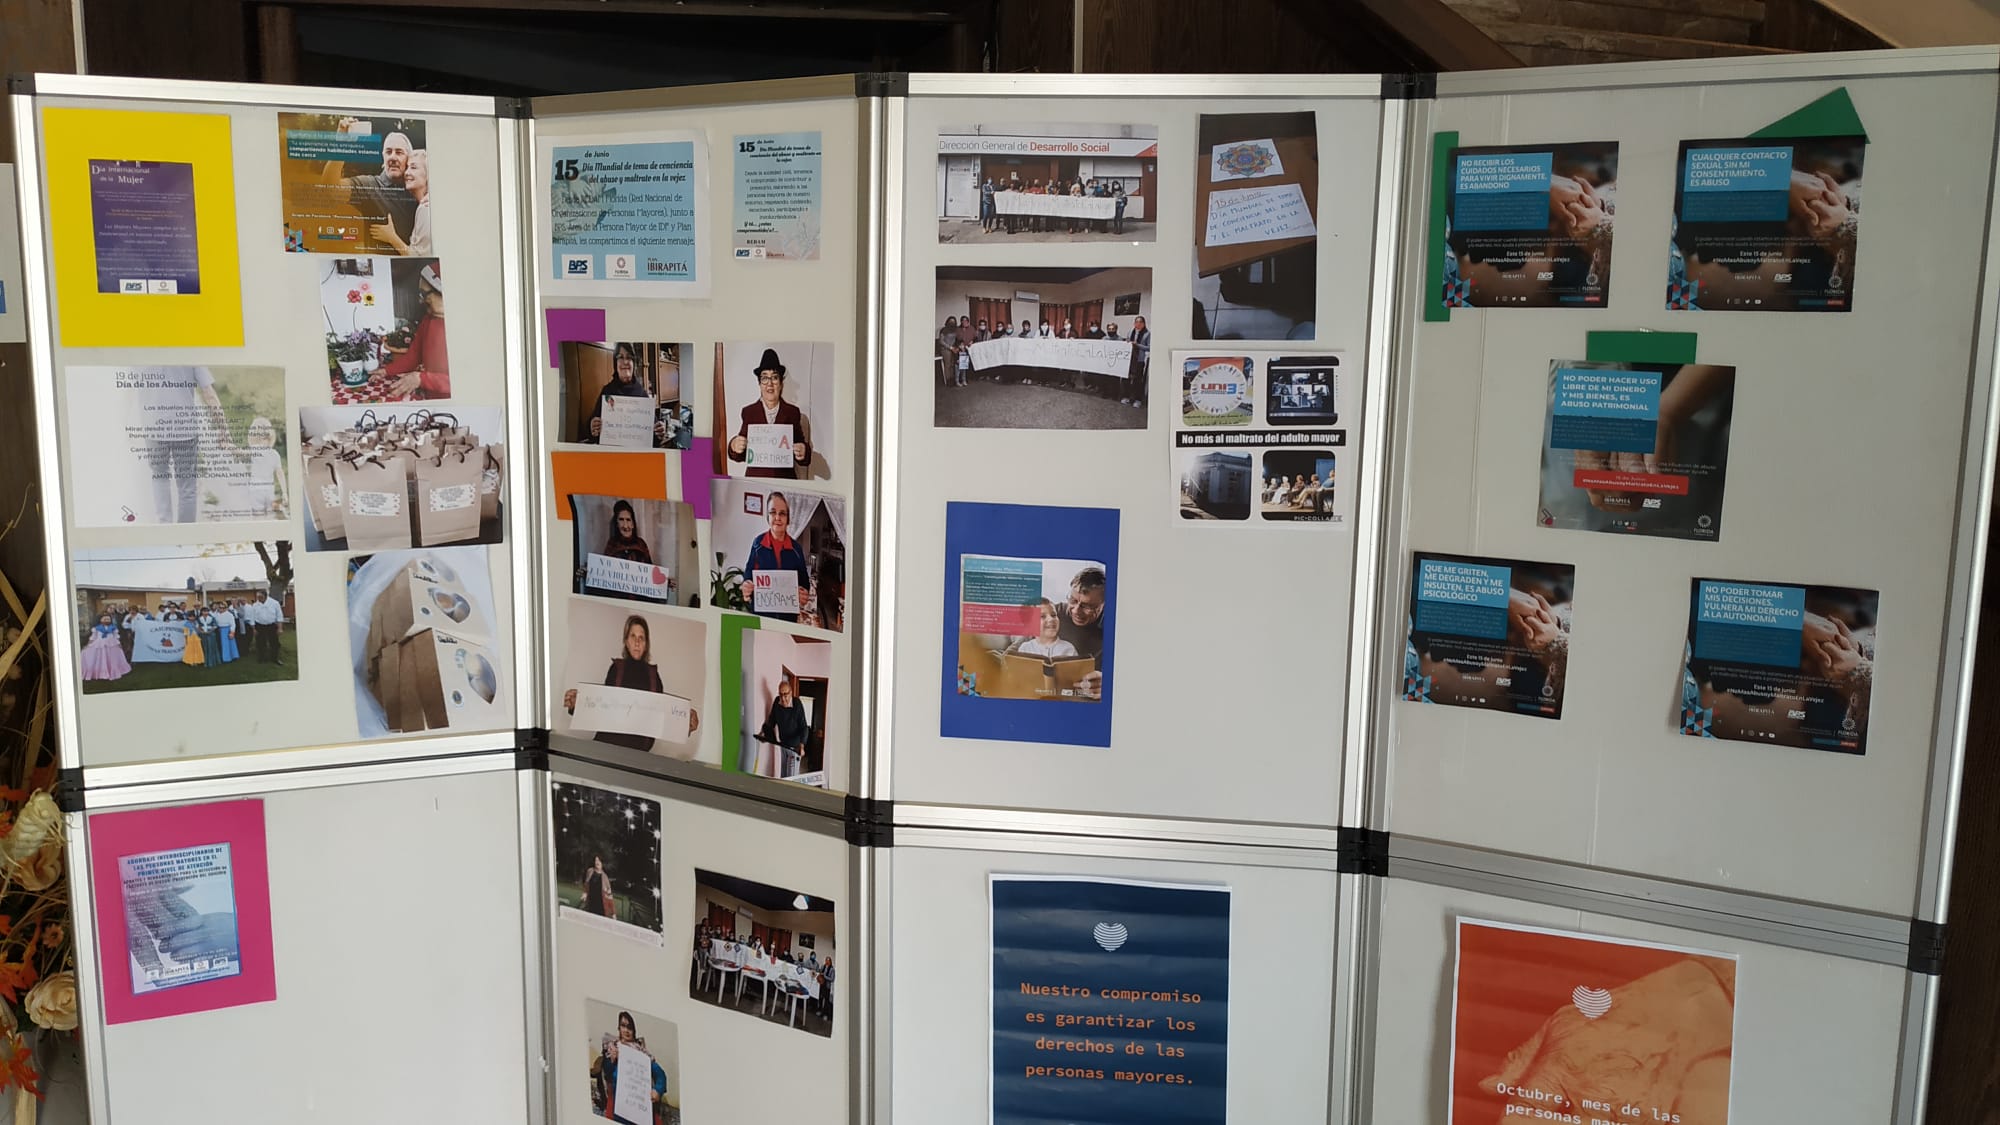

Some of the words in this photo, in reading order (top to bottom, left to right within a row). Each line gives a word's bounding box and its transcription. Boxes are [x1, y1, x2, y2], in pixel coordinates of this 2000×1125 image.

[739, 142, 755, 152] 15
[940, 140, 979, 150] Dirección
[982, 141, 1016, 150] General
[1017, 142, 1028, 151] de
[1030, 142, 1078, 152] Desarrollo
[1081, 142, 1110, 153] Social
[1692, 153, 1740, 162] CUALQUIER
[1741, 152, 1788, 160] CONTACTO
[555, 159, 579, 181] 15
[582, 162, 593, 172] Día
[595, 162, 622, 171] Mundial
[624, 162, 631, 170] de
[650, 161, 657, 170] de
[1691, 161, 1722, 170] SEXUAL
[1724, 161, 1737, 169] SIN
[1738, 161, 1750, 169] MI
[118, 175, 144, 184] Mujer
[662, 173, 669, 182] la
[670, 173, 686, 183] vejez
[1690, 179, 1699, 187] ES
[1701, 178, 1729, 186] ABUSO
[1460, 182, 1468, 190] ES
[645, 193, 672, 202] Nacional
[674, 193, 682, 202] de
[568, 260, 588, 270] BPS
[648, 260, 687, 272] IBIRAPITÁ
[116, 372, 125, 380] 19
[128, 372, 139, 380] de
[141, 372, 165, 381] junio
[116, 380, 132, 388] Día
[134, 380, 145, 388] de
[147, 380, 160, 389] los
[162, 380, 198, 389] Abuelos
[1561, 401, 1590, 409] ABUSO
[1592, 402, 1649, 411] PATRIMONIAL
[779, 435, 790, 449] A
[1182, 434, 1193, 444] No
[1195, 433, 1214, 444] más
[1216, 434, 1224, 443] al
[1226, 434, 1263, 443] maltrato
[1265, 433, 1279, 443] del
[1281, 433, 1309, 443] adulto
[1311, 434, 1339, 444] mayor
[1425, 564, 1442, 573] QUE
[756, 575, 770, 588] NO
[1424, 573, 1437, 581] ME
[1439, 574, 1482, 585] DEGRADEN
[1490, 579, 1503, 587] ME
[1423, 590, 1477, 601] PSICOLÓGICO
[1476, 587, 1504, 595] ABUSO
[1705, 586, 1718, 594] NO
[1720, 587, 1750, 596] PODER
[1751, 590, 1783, 599] TOMAR
[1705, 594, 1722, 602] MIS
[1705, 602, 1744, 612] VULNERA
[1745, 605, 1756, 613] MI
[1758, 606, 1799, 617] DERECHO
[1723, 612, 1777, 623] AUTONOMÍA
[157, 848, 214, 860] INTERDISCIPLINARIO
[146, 860, 174, 870] PERSONAS
[187, 862, 213, 870] ATENCIÓN
[1021, 983, 1091, 998] Nuestro
[1101, 989, 1201, 1003] compromiso
[1026, 1012, 1045, 1023] es
[1056, 1013, 1155, 1028] garantizar
[1167, 1017, 1196, 1031] los
[1036, 1037, 1114, 1054] derechos
[1125, 1041, 1144, 1055] de
[1156, 1043, 1185, 1057] las
[1026, 1064, 1104, 1080] personas
[1115, 1071, 1193, 1084] mayores.
[1497, 1082, 1571, 1107] Octubre,
[1582, 1098, 1610, 1112] mes
[1621, 1104, 1640, 1117] de
[1652, 1108, 1680, 1124] las
[1506, 1104, 1581, 1125] personas
